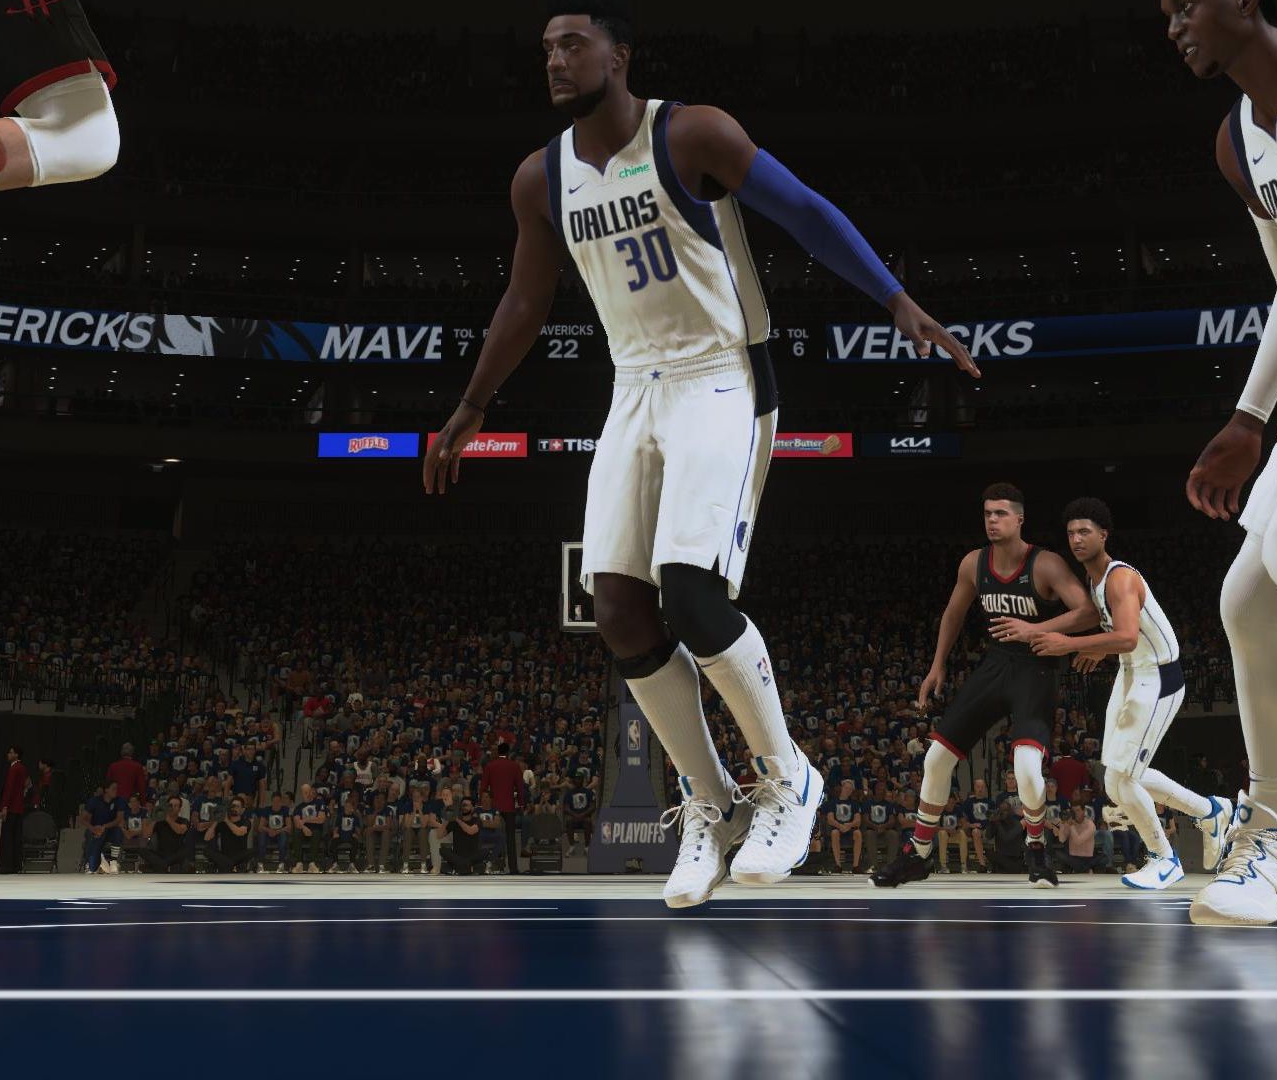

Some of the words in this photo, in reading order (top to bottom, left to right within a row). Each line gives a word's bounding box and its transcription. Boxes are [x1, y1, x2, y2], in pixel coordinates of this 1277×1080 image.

[569, 188, 661, 243] DALLAS
[614, 225, 679, 293] 30
[453, 327, 475, 339] TOL
[540, 324, 594, 336] AVERICKS
[787, 328, 810, 339] TOL
[457, 341, 469, 357] 7
[547, 338, 579, 359] 22
[793, 341, 805, 357] 6
[348, 436, 389, 454] RUFFLES
[981, 592, 1039, 617] HOUSTON
[611, 821, 666, 844] PLAYOFFS
